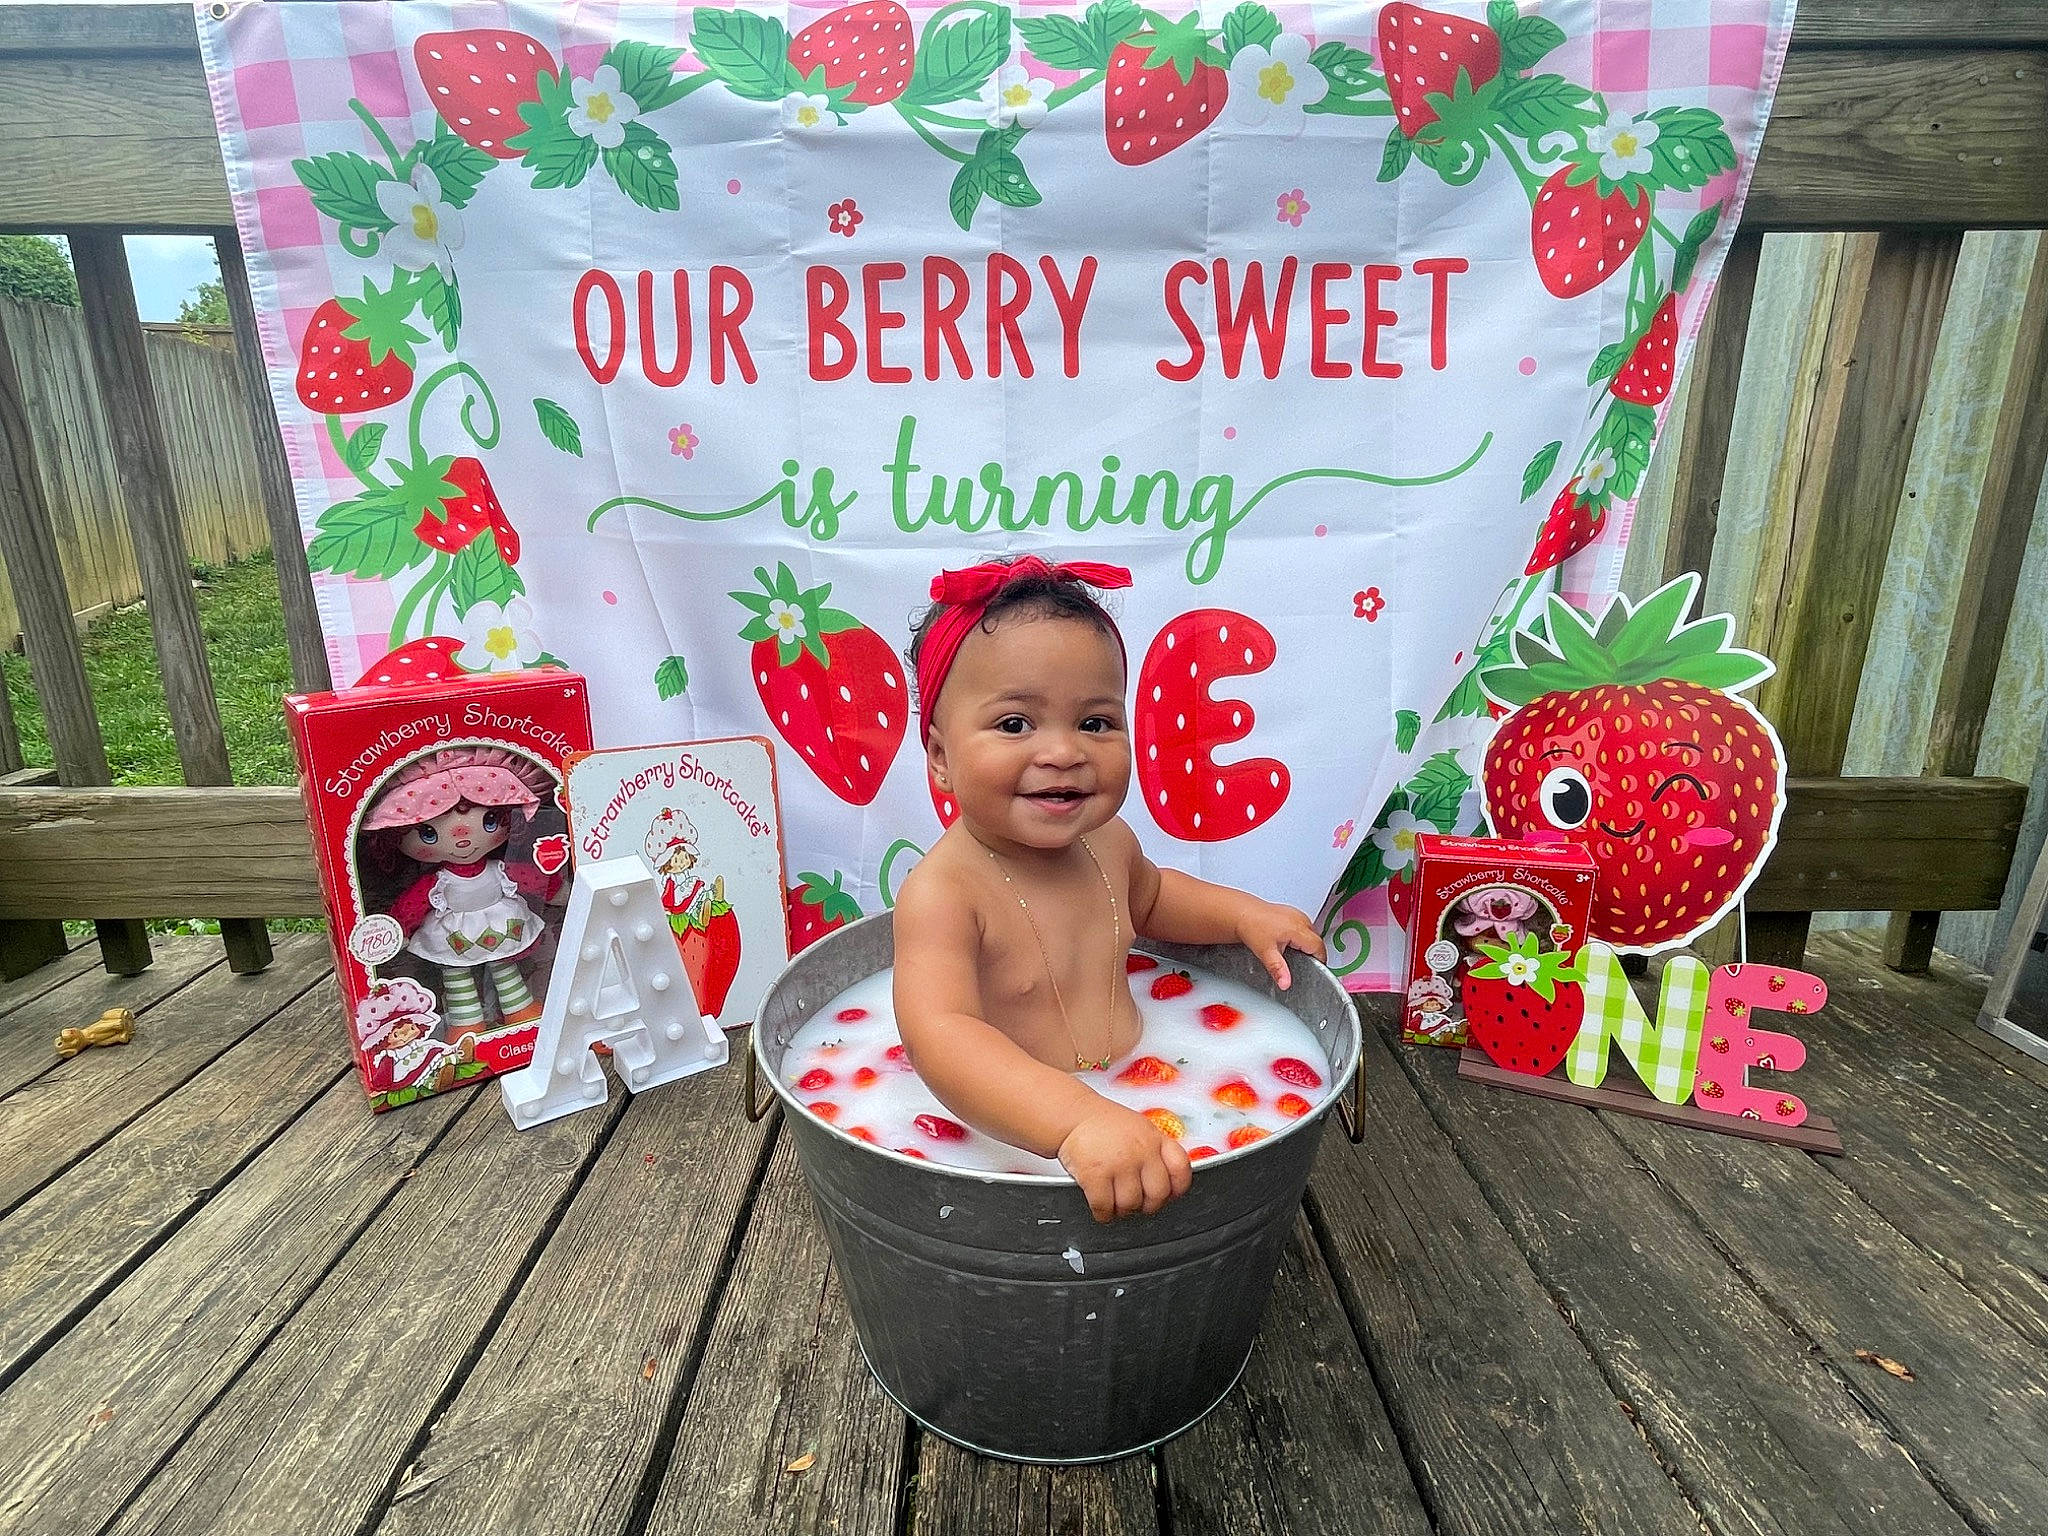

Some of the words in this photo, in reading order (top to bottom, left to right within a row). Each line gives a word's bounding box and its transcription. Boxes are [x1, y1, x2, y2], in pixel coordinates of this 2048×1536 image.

[572, 265, 759, 387] OUR
[806, 253, 1098, 384] BERRY
[1156, 256, 1470, 382] SWEET
[882, 415, 1494, 585] turning
[563, 688, 577, 699] 3+
[325, 713, 451, 798] Strawberry
[463, 703, 575, 759] Shortcake
[583, 761, 676, 860] Strawberry
[1439, 840, 1506, 851] Strawberry
[1507, 844, 1568, 854] Shortcake
[1435, 868, 1506, 900] Strawberry
[1575, 873, 1591, 883] 3+
[499, 1039, 537, 1059] Class
